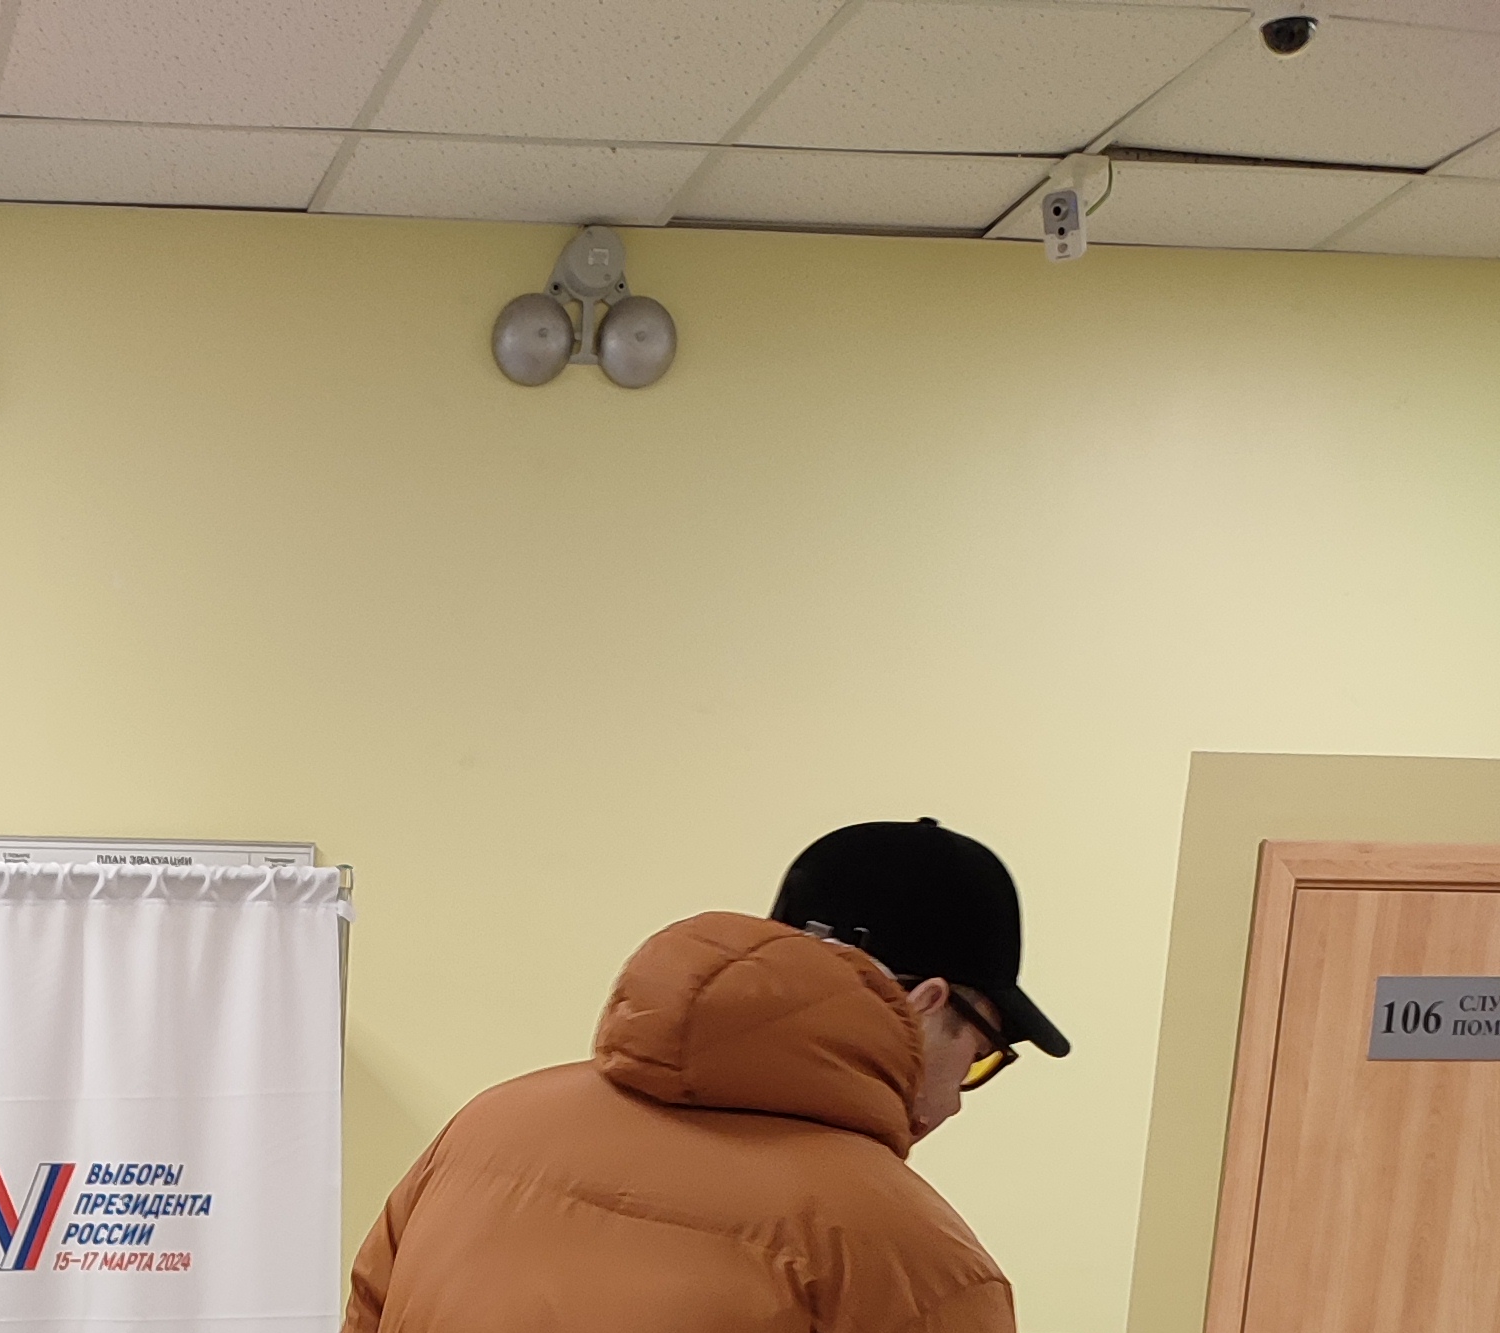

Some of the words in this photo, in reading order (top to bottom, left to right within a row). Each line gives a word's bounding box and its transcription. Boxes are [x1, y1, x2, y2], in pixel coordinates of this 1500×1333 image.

[1381, 1000, 1444, 1034] 106
[85, 1163, 184, 1185] ВЫБОРЫ
[73, 1193, 212, 1219] ПРЕЗИДЕНТА
[61, 1223, 155, 1245] РОССИИ
[98, 1252, 152, 1271] МАРТА
[155, 1252, 192, 1271] 2024
